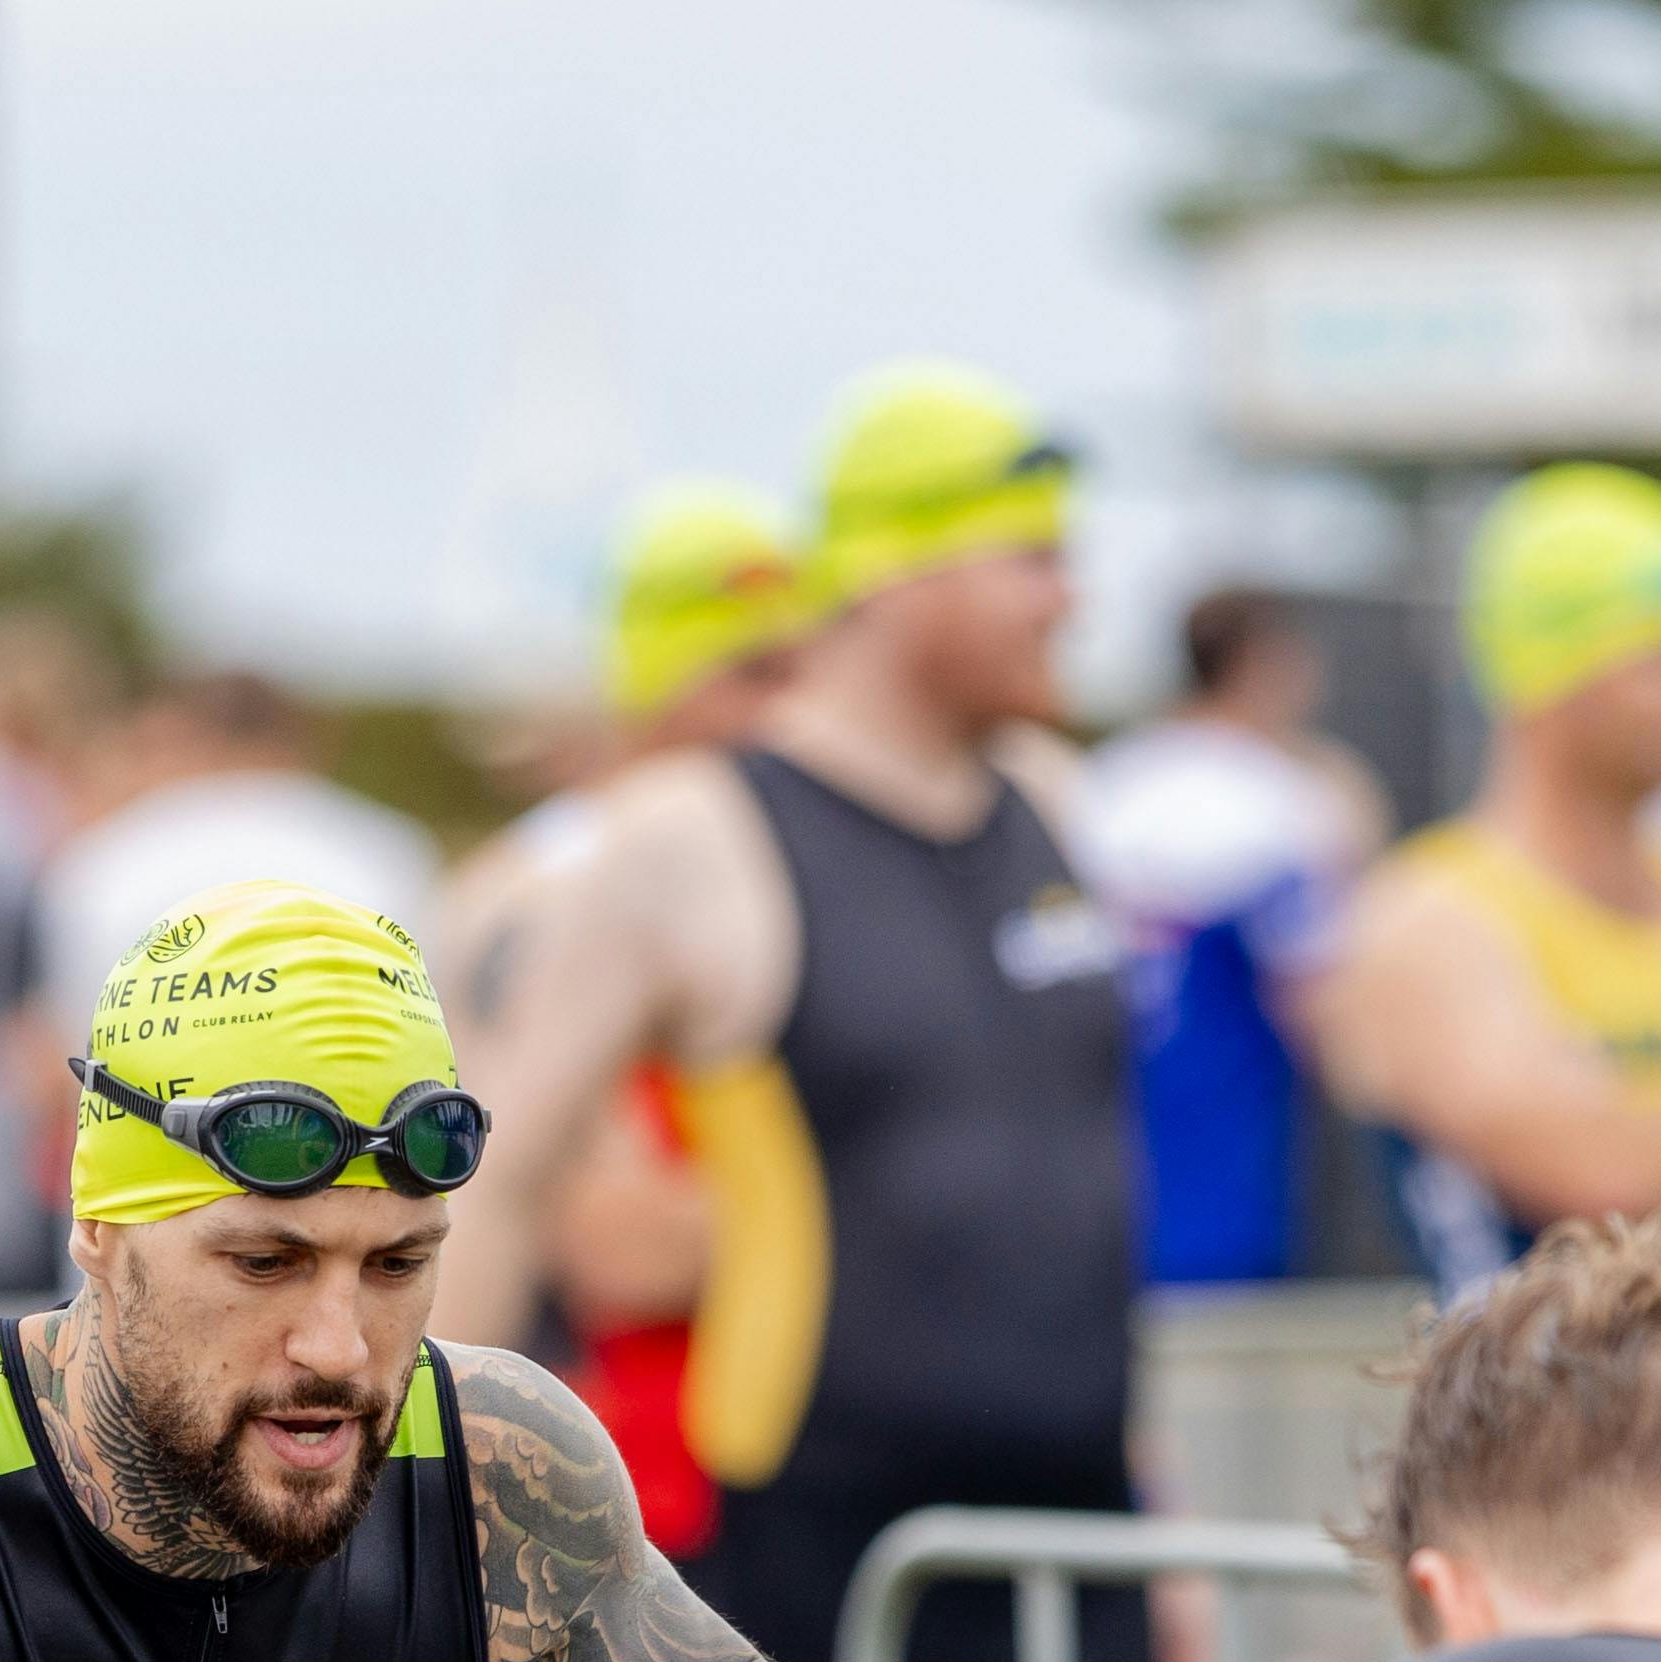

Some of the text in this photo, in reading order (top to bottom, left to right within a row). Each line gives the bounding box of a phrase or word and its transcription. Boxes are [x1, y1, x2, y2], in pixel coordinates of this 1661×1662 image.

[150, 967, 279, 1005] TEAMS
[193, 1016, 227, 1030] CLUB
[231, 1011, 275, 1024] RELAY
